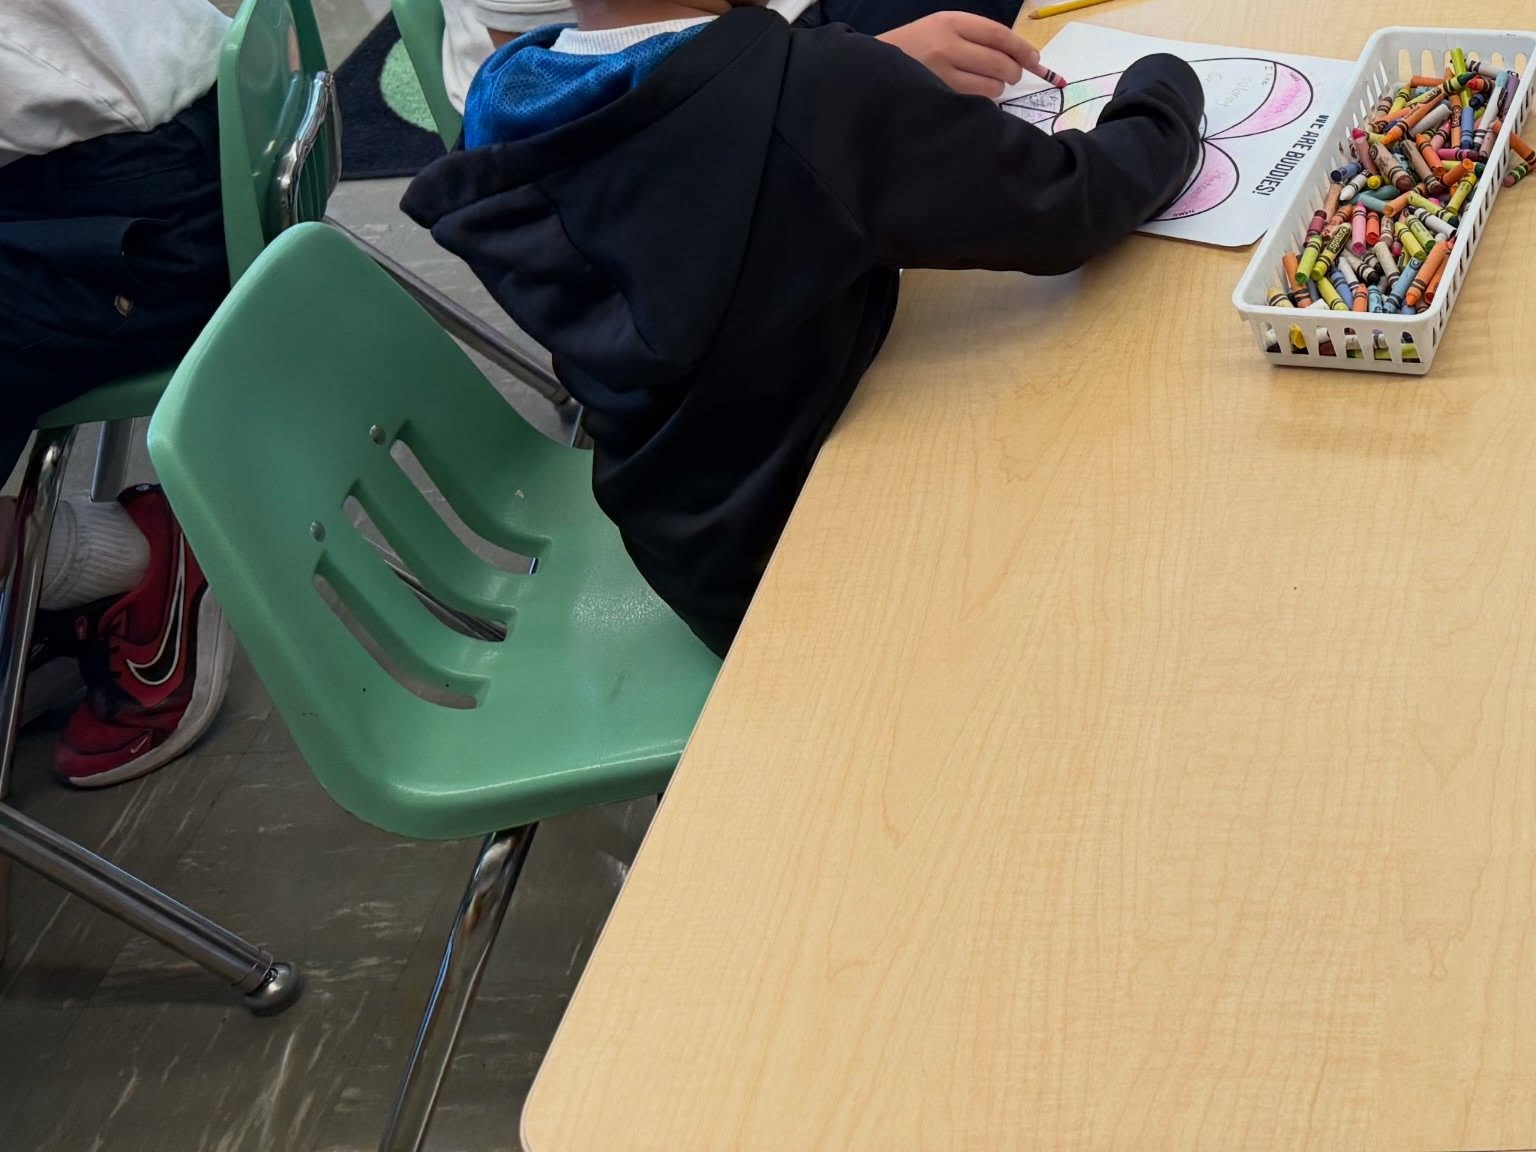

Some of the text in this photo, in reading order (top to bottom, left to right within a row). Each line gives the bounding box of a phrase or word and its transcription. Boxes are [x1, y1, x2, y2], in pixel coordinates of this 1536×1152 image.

[1311, 114, 1330, 129] WE
[1293, 130, 1319, 151] ARE
[1252, 150, 1305, 196] BUDDIES!
